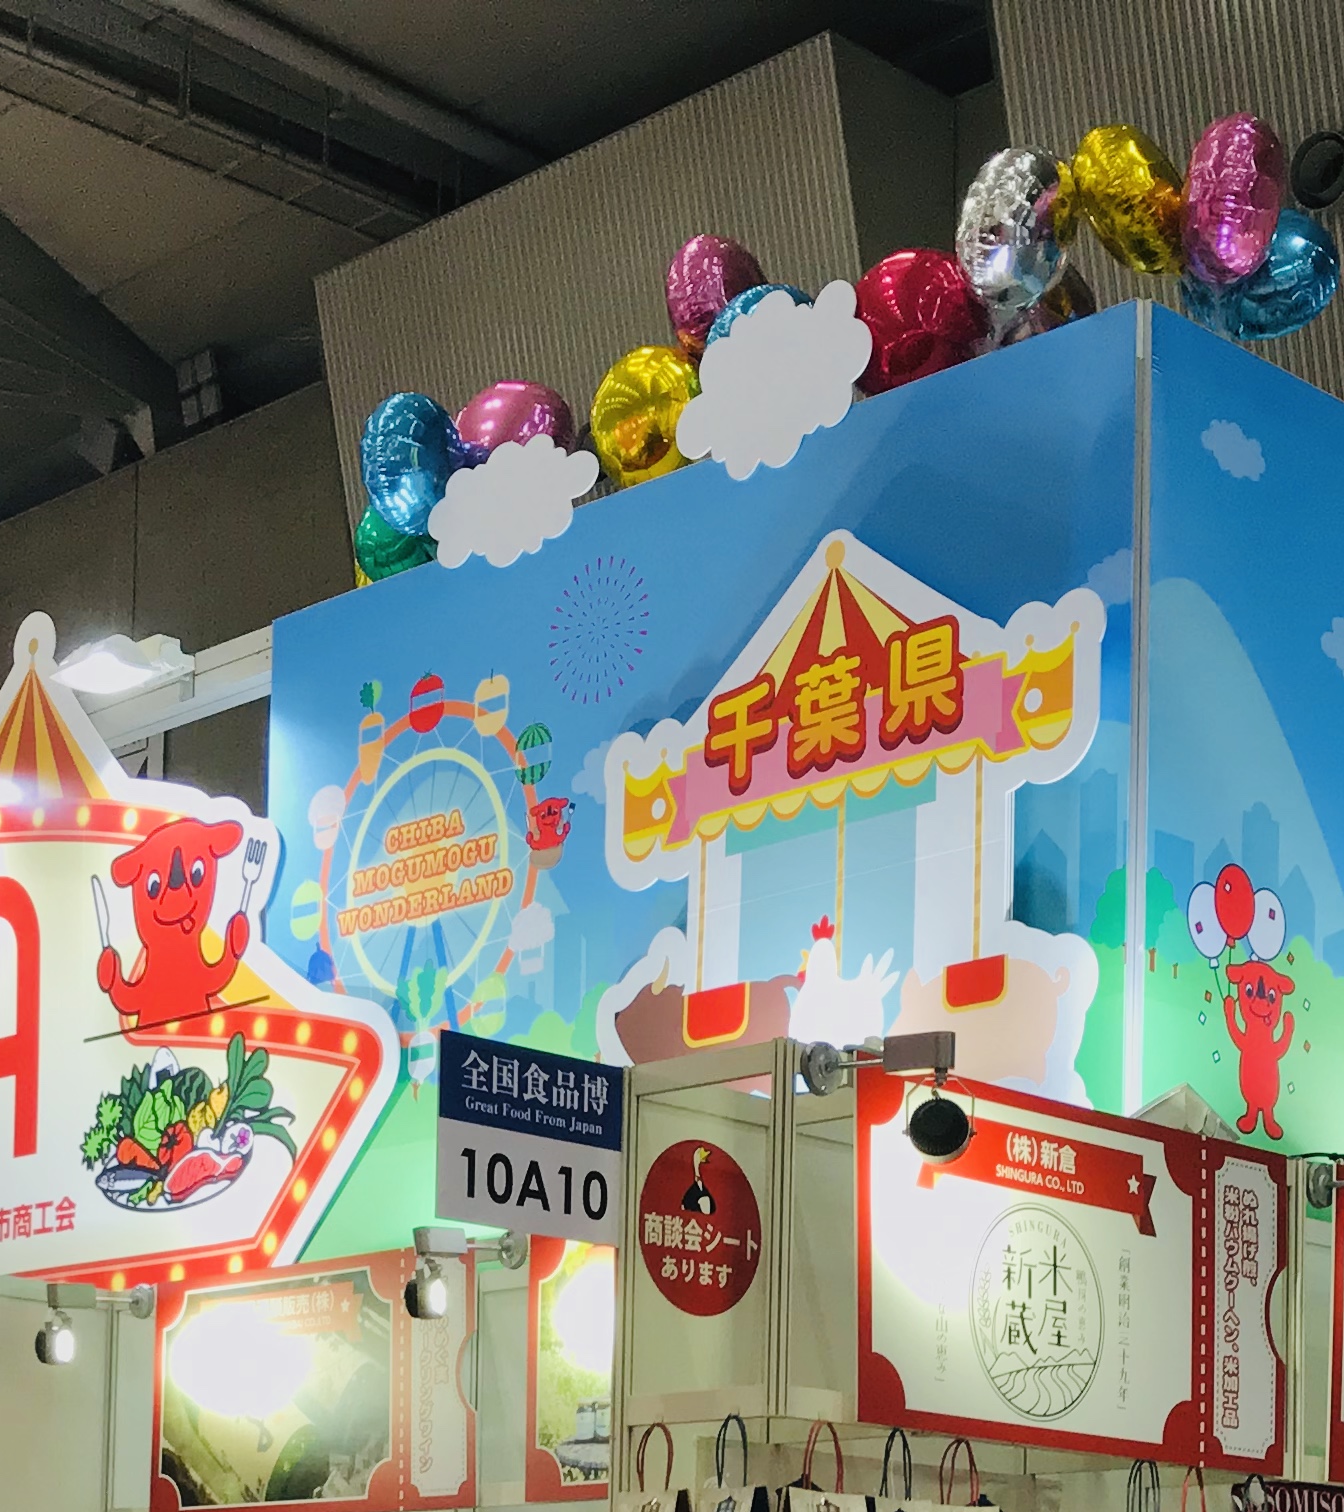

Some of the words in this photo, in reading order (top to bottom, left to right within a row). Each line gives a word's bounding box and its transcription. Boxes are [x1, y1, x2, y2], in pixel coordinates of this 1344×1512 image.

[704, 614, 964, 796] 千葉県
[386, 809, 465, 854] CHIBA
[353, 834, 498, 897] MOGUMOGU
[338, 868, 513, 937] WONDERLAND
[460, 1048, 610, 1117] 全国食品博
[465, 1095, 499, 1117] Great
[502, 1102, 532, 1122] Food
[535, 1109, 567, 1129] From
[569, 1115, 604, 1136] Japan
[995, 1163, 1044, 1187] SHINGURA
[1066, 1178, 1085, 1195] LTD
[1006, 1131, 1077, 1174] (株)新倉
[460, 1147, 609, 1221] 10A10
[644, 1211, 758, 1263] 商談会シート
[1008, 1220, 1068, 1250] SHINGURA
[661, 1256, 734, 1289] あります
[1000, 1244, 1040, 1356] 新蔵
[1038, 1244, 1074, 1349] 米屋
